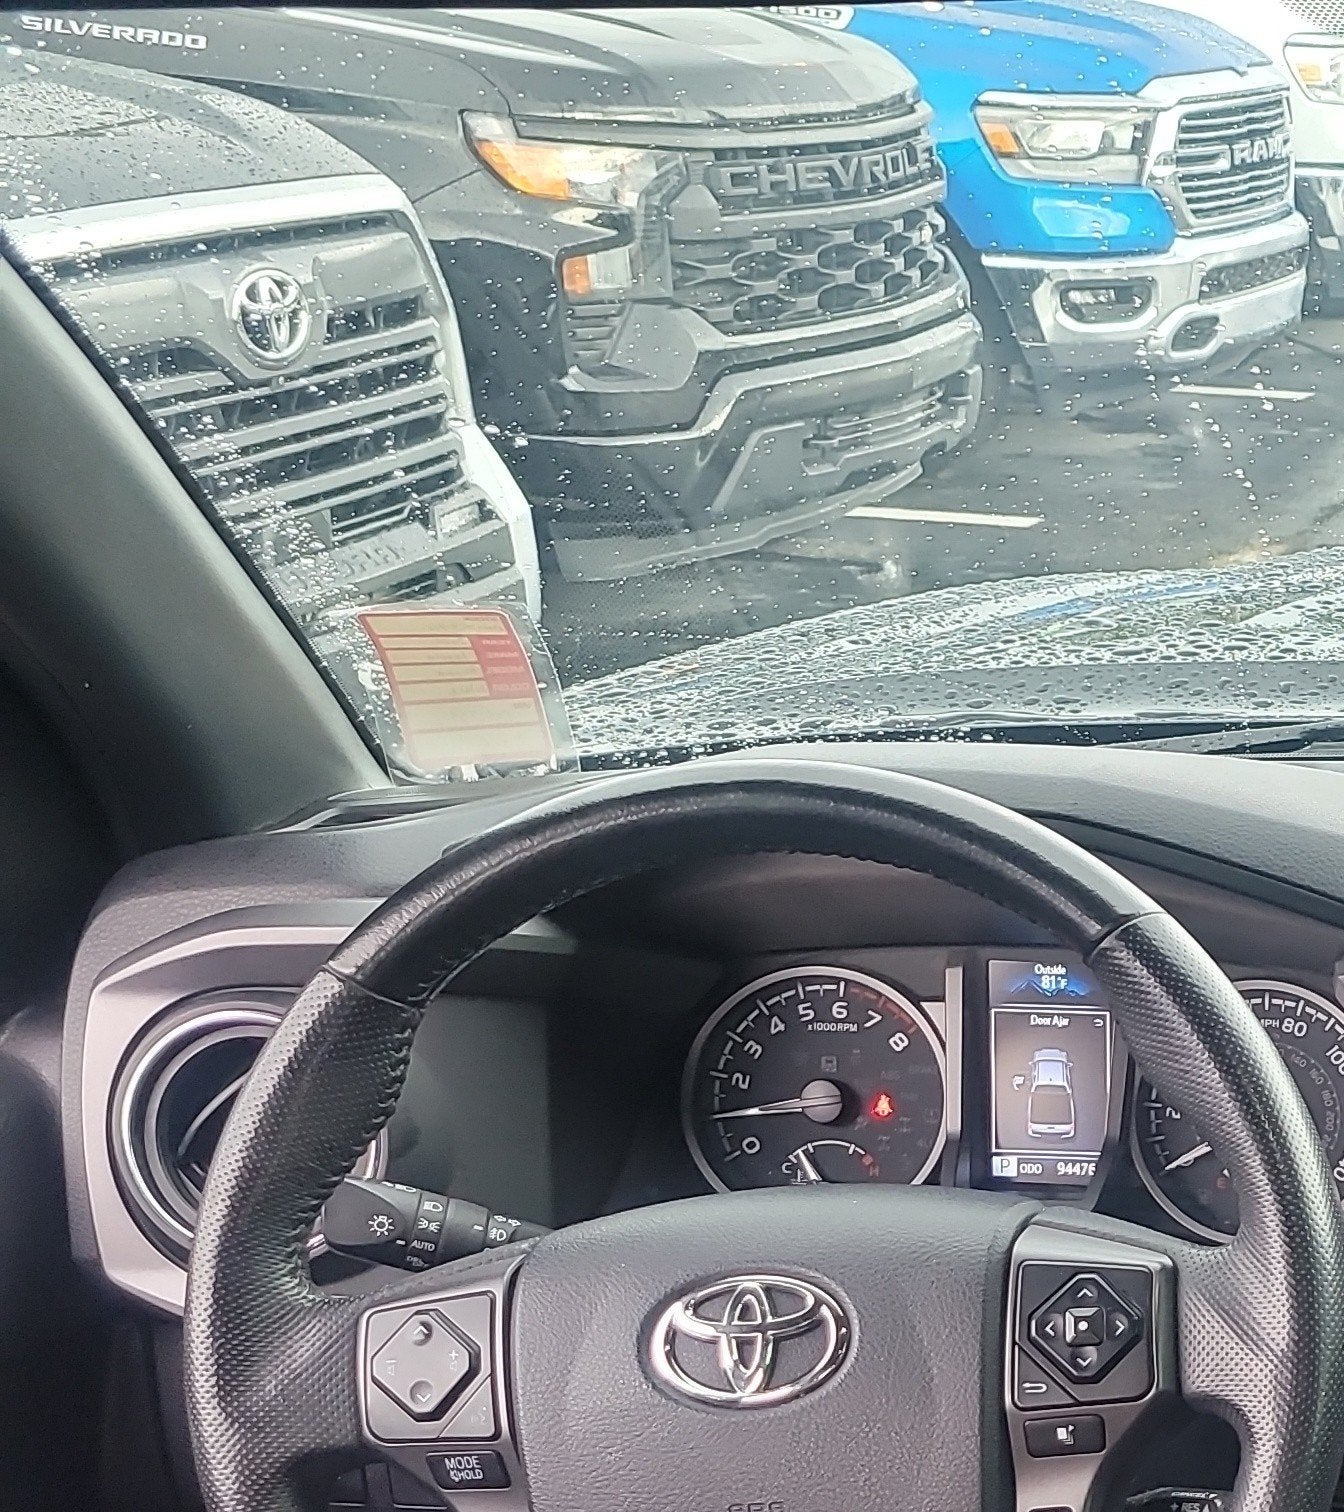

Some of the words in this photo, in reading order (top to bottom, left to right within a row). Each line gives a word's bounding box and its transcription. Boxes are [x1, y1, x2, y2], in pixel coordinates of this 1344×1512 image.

[20, 14, 208, 50] SILVERADO
[1034, 963, 1067, 975] Outside
[797, 1001, 816, 1023] 5
[831, 1001, 849, 1019] 6
[863, 1009, 883, 1028] 7
[769, 1015, 787, 1036] 4
[1029, 1014, 1051, 1026] Door
[1051, 1014, 1071, 1028] Ajar
[1280, 1017, 1308, 1038] 80
[743, 1039, 764, 1060] 3
[888, 1032, 910, 1052] 8
[731, 1072, 751, 1091] 2
[741, 1136, 762, 1155] 0
[1000, 1158, 1011, 1174] P
[1019, 1163, 1043, 1175] ODO
[410, 1239, 436, 1252] AUTO
[444, 1455, 482, 1470] MODE
[457, 1469, 484, 1481] HOLD
